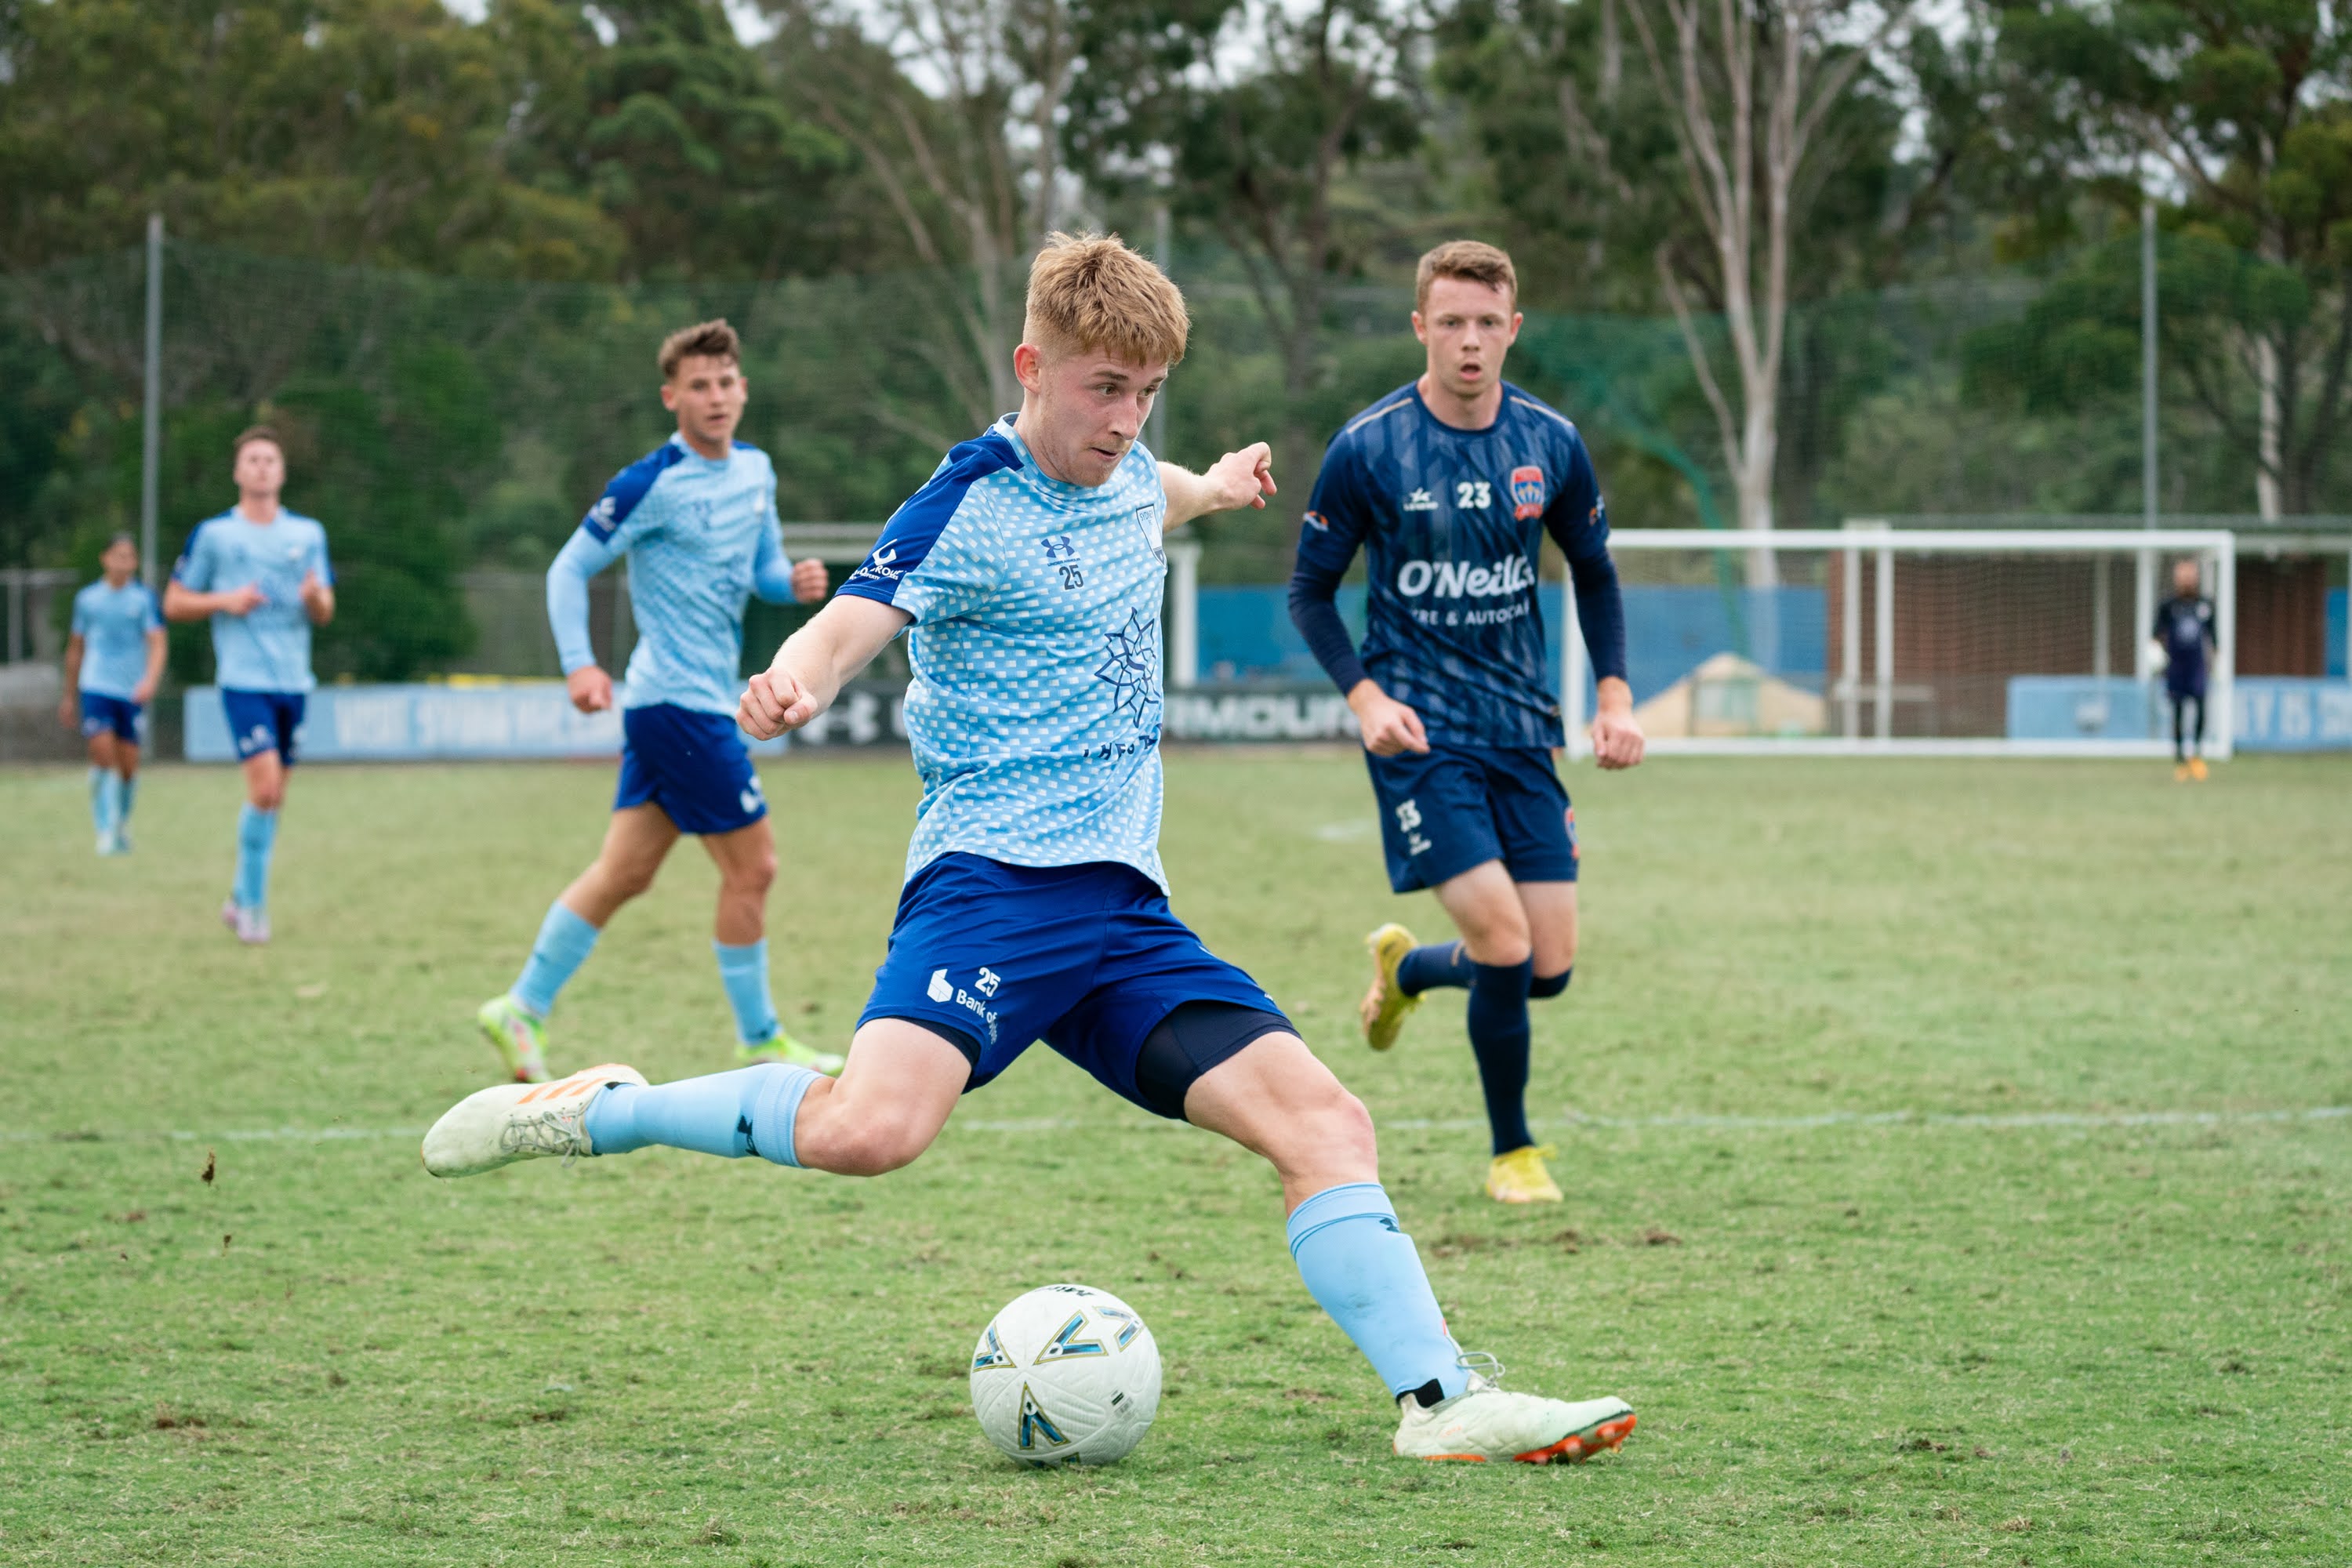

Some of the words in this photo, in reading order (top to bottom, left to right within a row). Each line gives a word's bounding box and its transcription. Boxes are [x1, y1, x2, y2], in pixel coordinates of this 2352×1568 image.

[1457, 481, 1490, 509] 23
[1058, 564, 1084, 590] 25
[1446, 611, 1458, 626] &
[975, 967, 1001, 998] 25
[956, 989, 986, 1018] Bank
[986, 1011, 998, 1024] of
